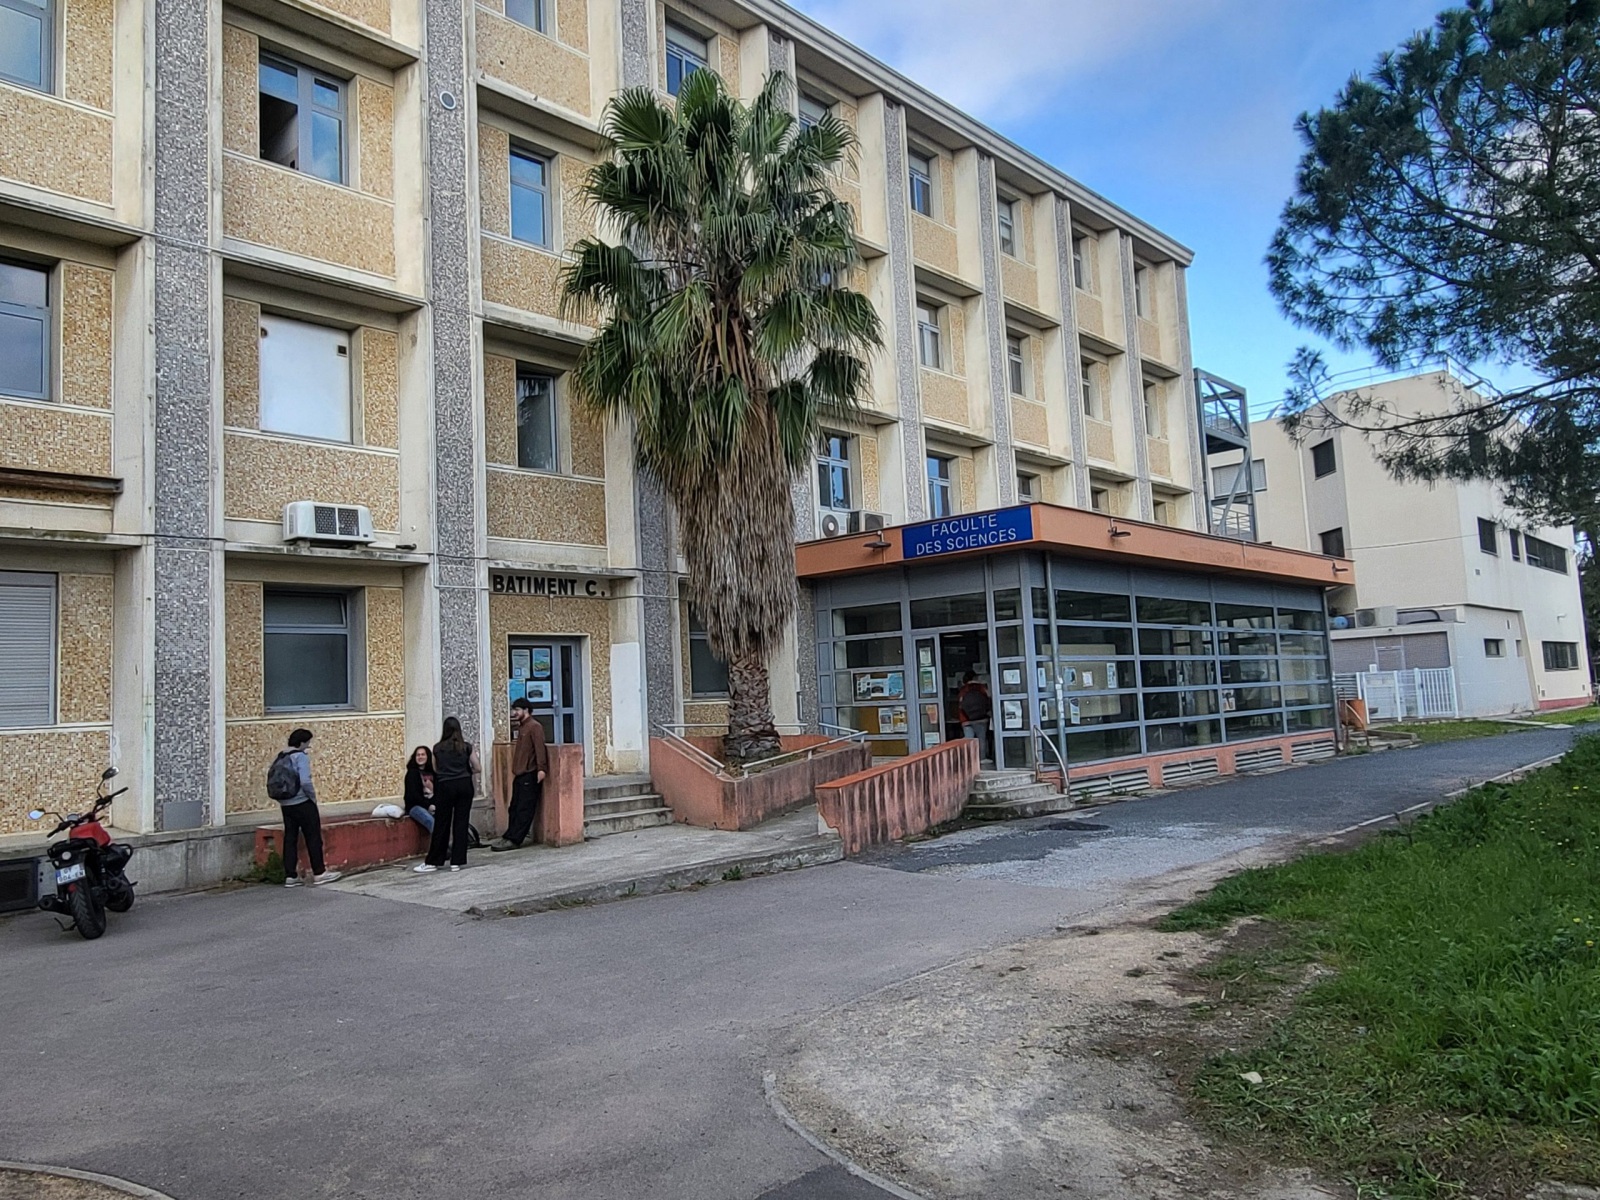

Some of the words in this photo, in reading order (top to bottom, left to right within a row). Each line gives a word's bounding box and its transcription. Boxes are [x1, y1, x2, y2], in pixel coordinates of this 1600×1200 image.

[931, 513, 998, 537] FACULTE
[916, 540, 942, 555] DES
[946, 528, 1017, 550] SCIENCES
[492, 574, 577, 596] BATIMENT
